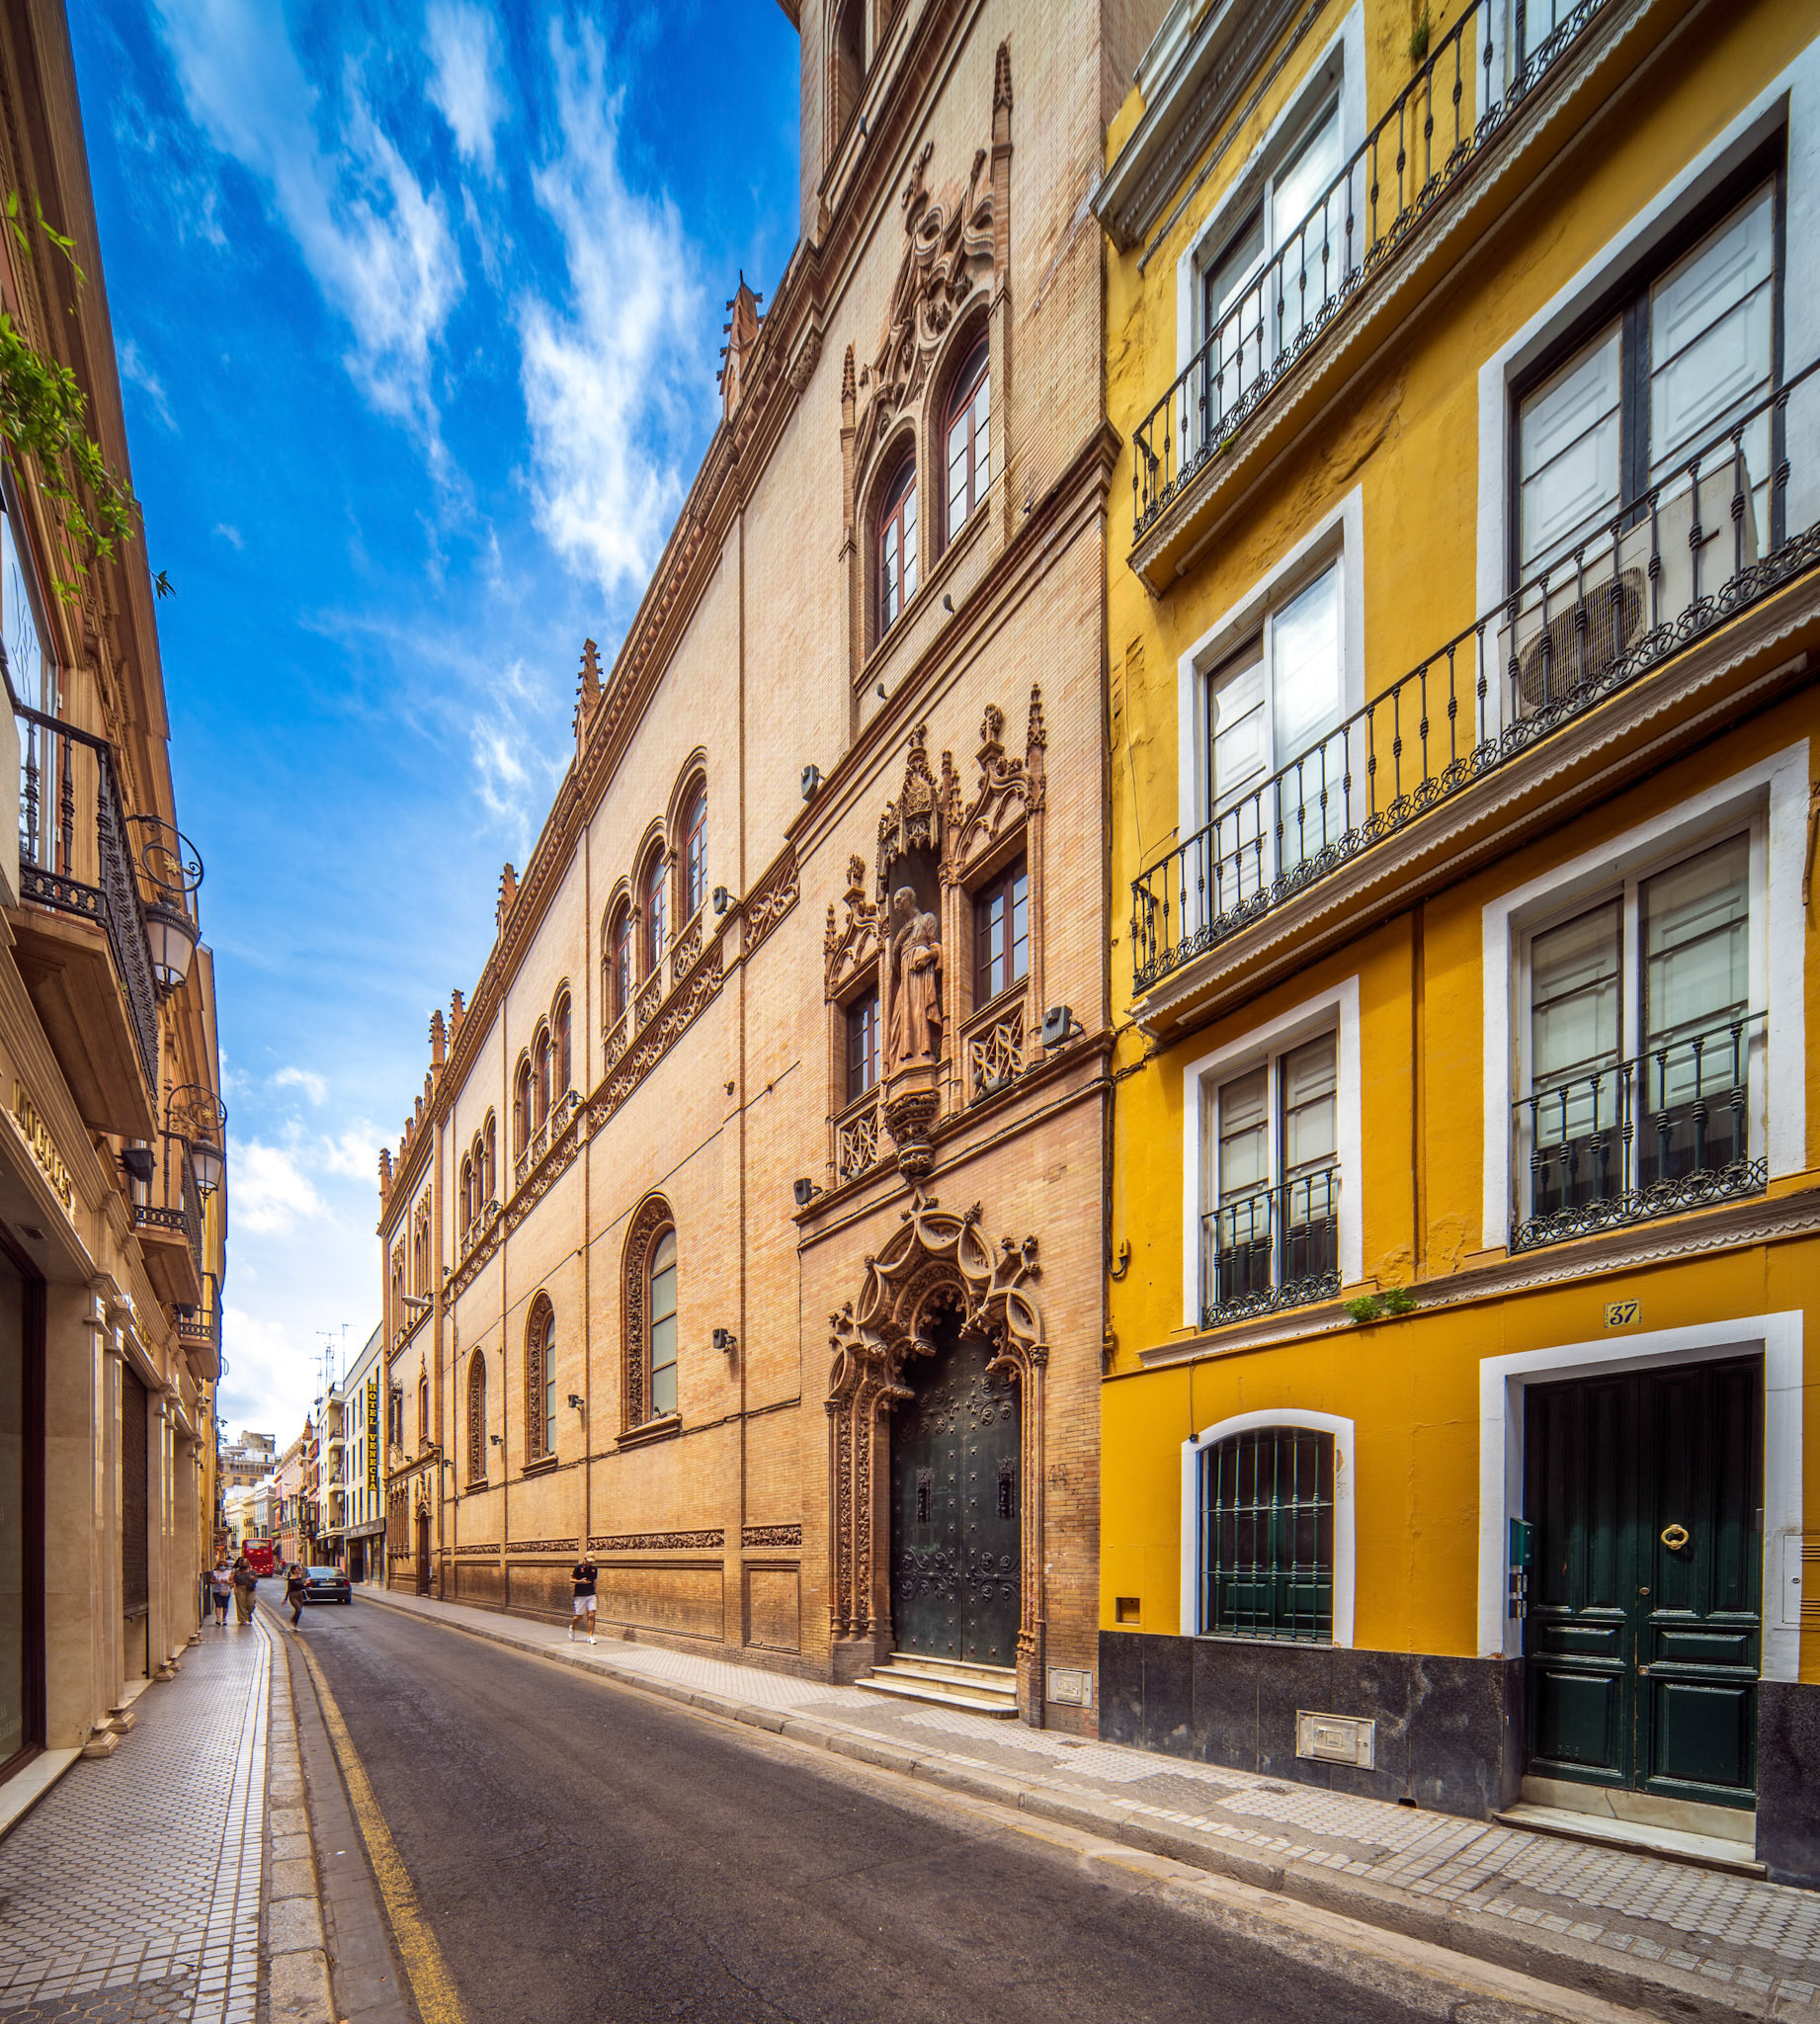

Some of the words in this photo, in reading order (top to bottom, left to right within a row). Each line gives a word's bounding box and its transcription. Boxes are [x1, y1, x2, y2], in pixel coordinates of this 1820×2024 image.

[1610, 1303, 1638, 1325] 37
[368, 1384, 377, 1425] HOTEL
[368, 1434, 377, 1490] VENECIA
